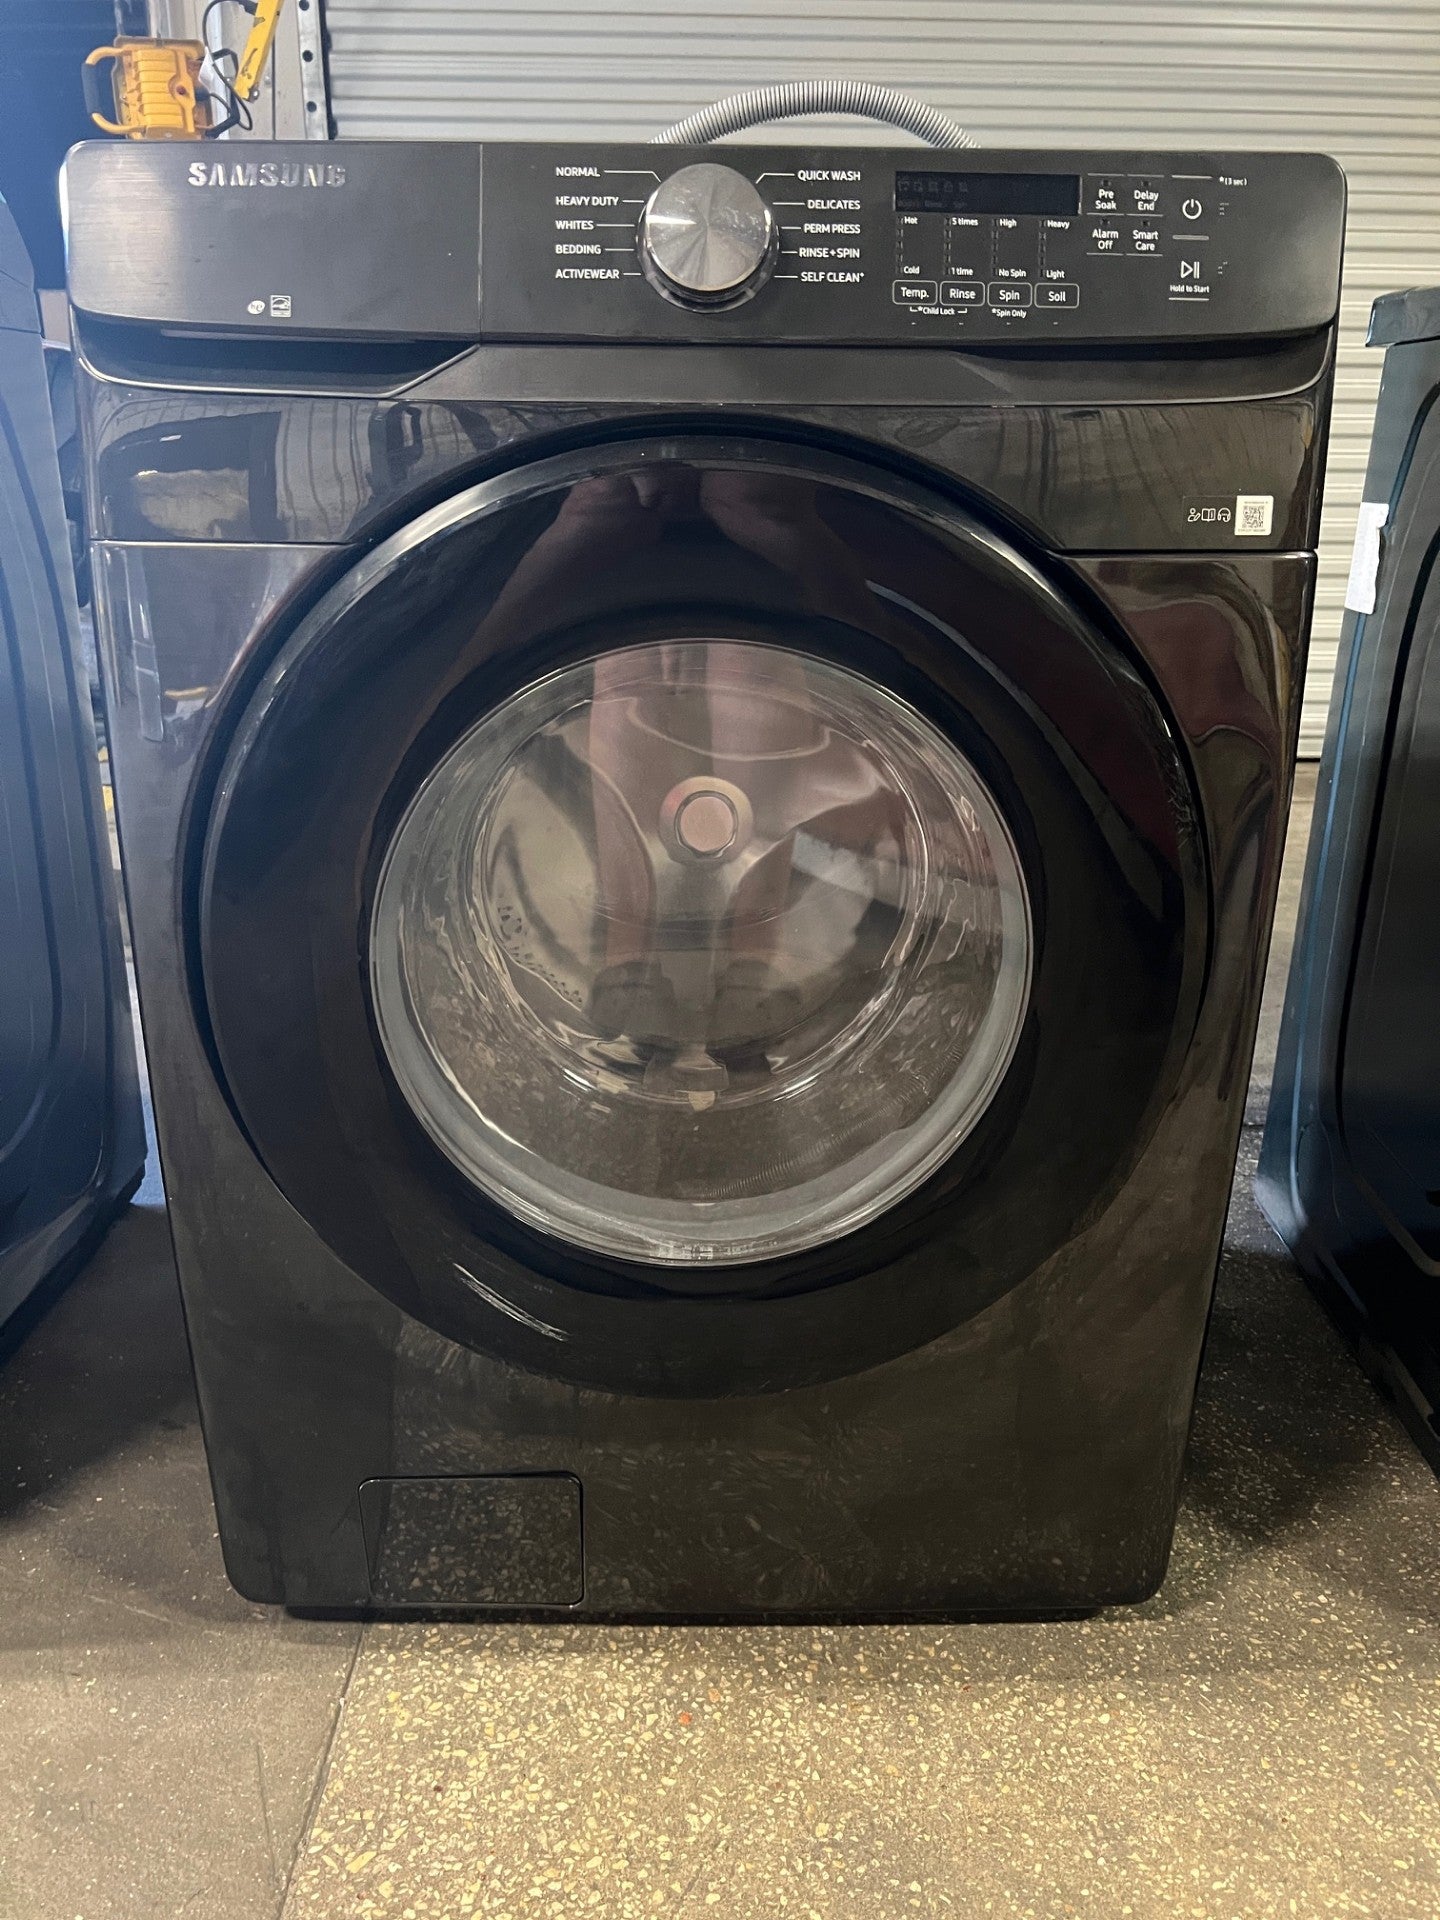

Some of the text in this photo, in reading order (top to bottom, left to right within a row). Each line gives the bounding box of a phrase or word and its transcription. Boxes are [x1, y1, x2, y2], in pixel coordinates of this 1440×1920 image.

[188, 162, 345, 187] SAMSUNG
[555, 167, 600, 177] NORMAL
[797, 170, 860, 181] QUICK WASH
[1098, 188, 1114, 199] Pre
[1134, 190, 1159, 202] Delay
[555, 196, 619, 206] HEAVY DUTY
[807, 200, 860, 210] DELICATES
[1095, 200, 1117, 210] Soak
[1137, 201, 1155, 211] End
[555, 220, 594, 230] WHITES
[904, 216, 918, 225] Hot
[952, 217, 979, 226] 5 times
[999, 218, 1017, 229] High
[1047, 220, 1070, 230] Heavy
[803, 223, 860, 234] PERM PRESS
[1092, 228, 1119, 239] Alarm
[1132, 229, 1159, 240] Smart
[555, 244, 602, 255] BEDDING
[1097, 240, 1113, 250] Off
[1135, 241, 1155, 251] Care
[555, 269, 620, 279] ACTIVEWEAR
[903, 266, 920, 275] Cold
[956, 267, 974, 276] time
[998, 268, 1027, 279] No Spin
[1046, 269, 1066, 280] Light
[800, 271, 825, 282] SELF
[900, 286, 930, 300] Temp.
[949, 287, 976, 300] Rinse
[1169, 284, 1210, 294] Hold to Start
[999, 289, 1021, 303] Spin
[1048, 291, 1067, 303] Soil
[940, 307, 956, 316] Lock
[1011, 309, 1027, 319] Only
